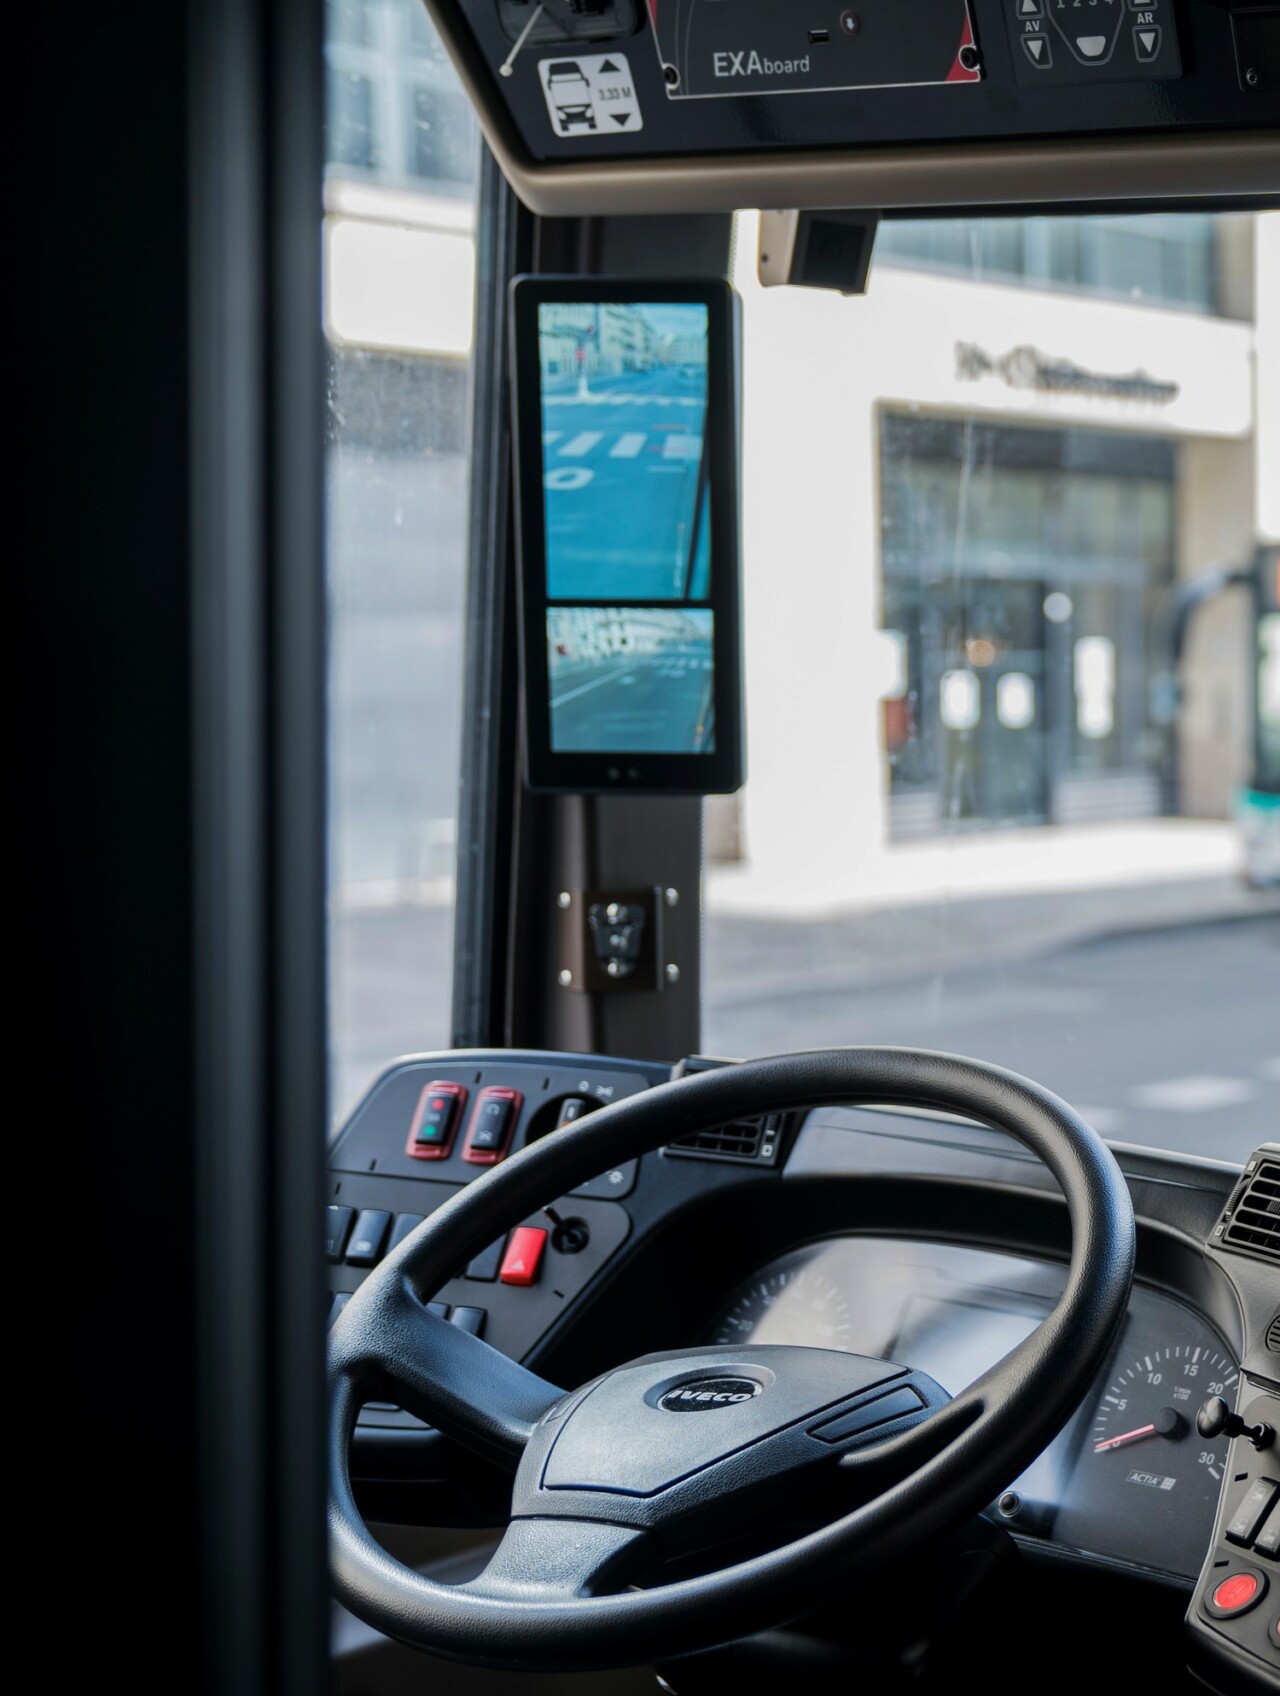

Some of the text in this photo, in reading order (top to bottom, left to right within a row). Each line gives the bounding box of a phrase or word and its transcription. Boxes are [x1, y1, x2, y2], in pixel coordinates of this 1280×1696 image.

[1137, 12, 1153, 24] AR
[1025, 20, 1040, 32] AV
[713, 50, 810, 77] EXAboard
[1183, 1364, 1199, 1376] 15
[1147, 1373, 1162, 1385] 10
[1207, 1382, 1224, 1395] 20
[668, 1390, 753, 1402] IVECO
[1117, 1399, 1127, 1411] 5
[1198, 1452, 1215, 1465] 30
